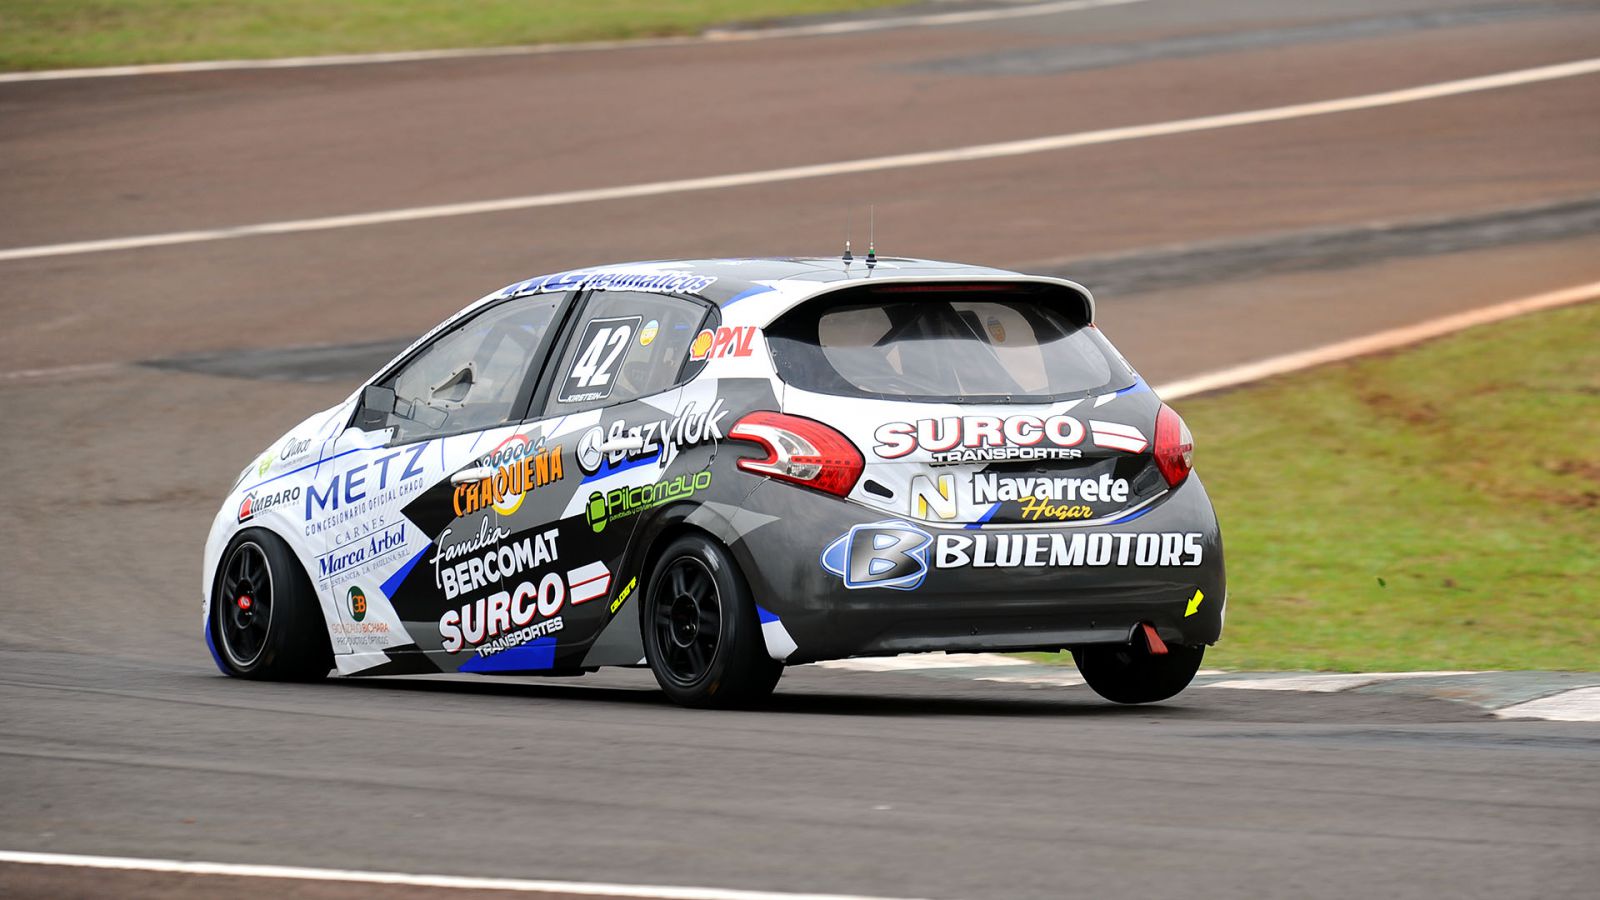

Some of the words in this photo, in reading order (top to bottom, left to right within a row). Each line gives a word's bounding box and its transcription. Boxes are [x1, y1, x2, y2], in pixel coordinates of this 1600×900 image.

[571, 325, 632, 388] 42
[709, 325, 757, 359] PAL
[873, 414, 1087, 460] SURCO
[932, 446, 1083, 463] TRANSPORTES
[305, 440, 430, 521] METZ
[607, 470, 712, 517] Pilcomayo
[972, 472, 1130, 504] Navarrete
[305, 503, 366, 536] CONCESIONARIO
[368, 491, 396, 511] OFICIAL
[399, 478, 424, 496] CHACO
[335, 515, 385, 545] CARNES
[1017, 495, 1094, 521] Hogar
[318, 548, 365, 579] Marca
[367, 523, 405, 558] Arbol
[441, 528, 560, 601] BERCOMAT
[935, 531, 1204, 569] BLUEMOTORS
[438, 571, 566, 654] SURCO
[475, 615, 564, 659] TRANSPORTES
